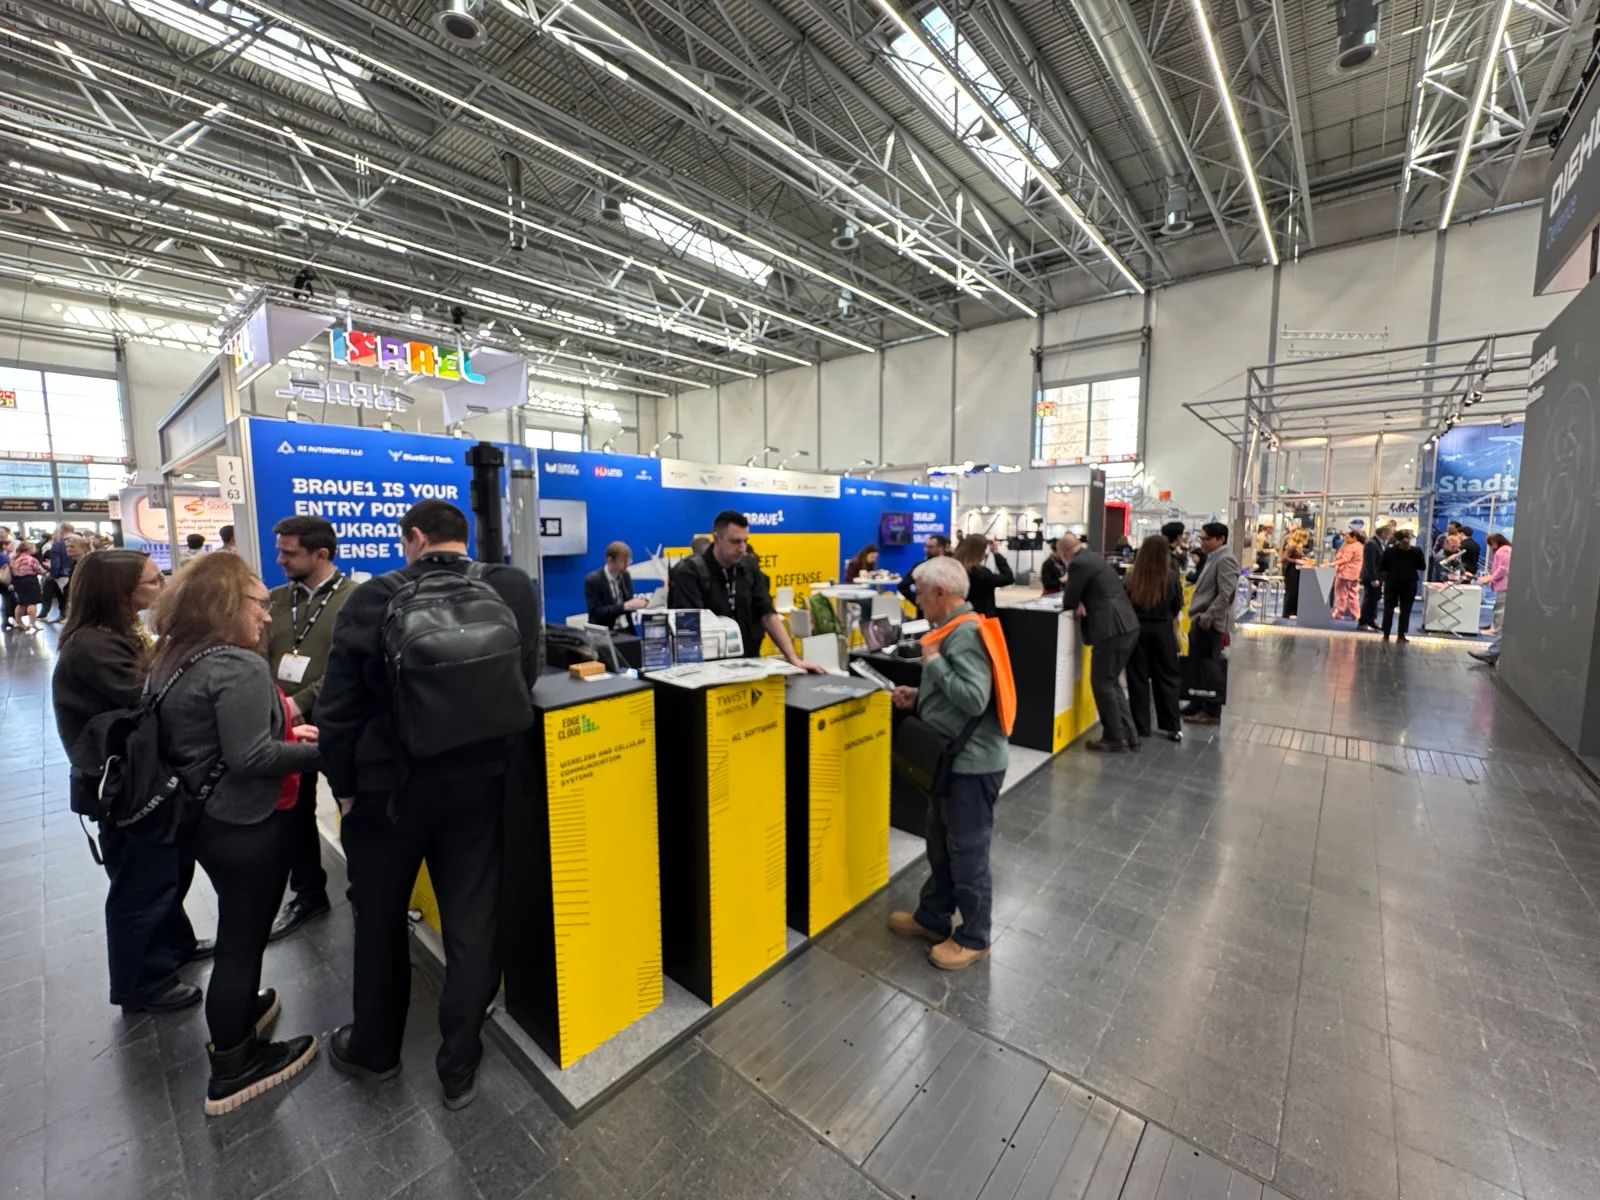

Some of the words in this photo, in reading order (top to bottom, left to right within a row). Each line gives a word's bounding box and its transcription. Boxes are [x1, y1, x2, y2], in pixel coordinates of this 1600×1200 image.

[330, 327, 486, 384] ISRAEL
[1528, 345, 1559, 387] DIEHL
[403, 451, 434, 463] BlueBird
[228, 461, 234, 471] 1
[229, 474, 237, 485] C
[1439, 472, 1515, 493] Stadt
[227, 489, 240, 500] 63
[292, 478, 377, 496] BRAVE1
[382, 482, 405, 498] IS
[409, 483, 459, 499] YOUR
[295, 501, 365, 517] ENTRY
[331, 522, 403, 538] UKRAI
[336, 543, 391, 559] ENSE
[758, 554, 779, 568] EET
[775, 571, 822, 587] DEFENSE
[716, 689, 748, 706] TWIST
[562, 715, 581, 728] EDGE
[558, 726, 582, 741] CLOUD
[732, 733, 742, 742] AI
[743, 720, 778, 737] SOFTWARE
[560, 752, 597, 768] WIRELESS
[598, 747, 613, 757] AND
